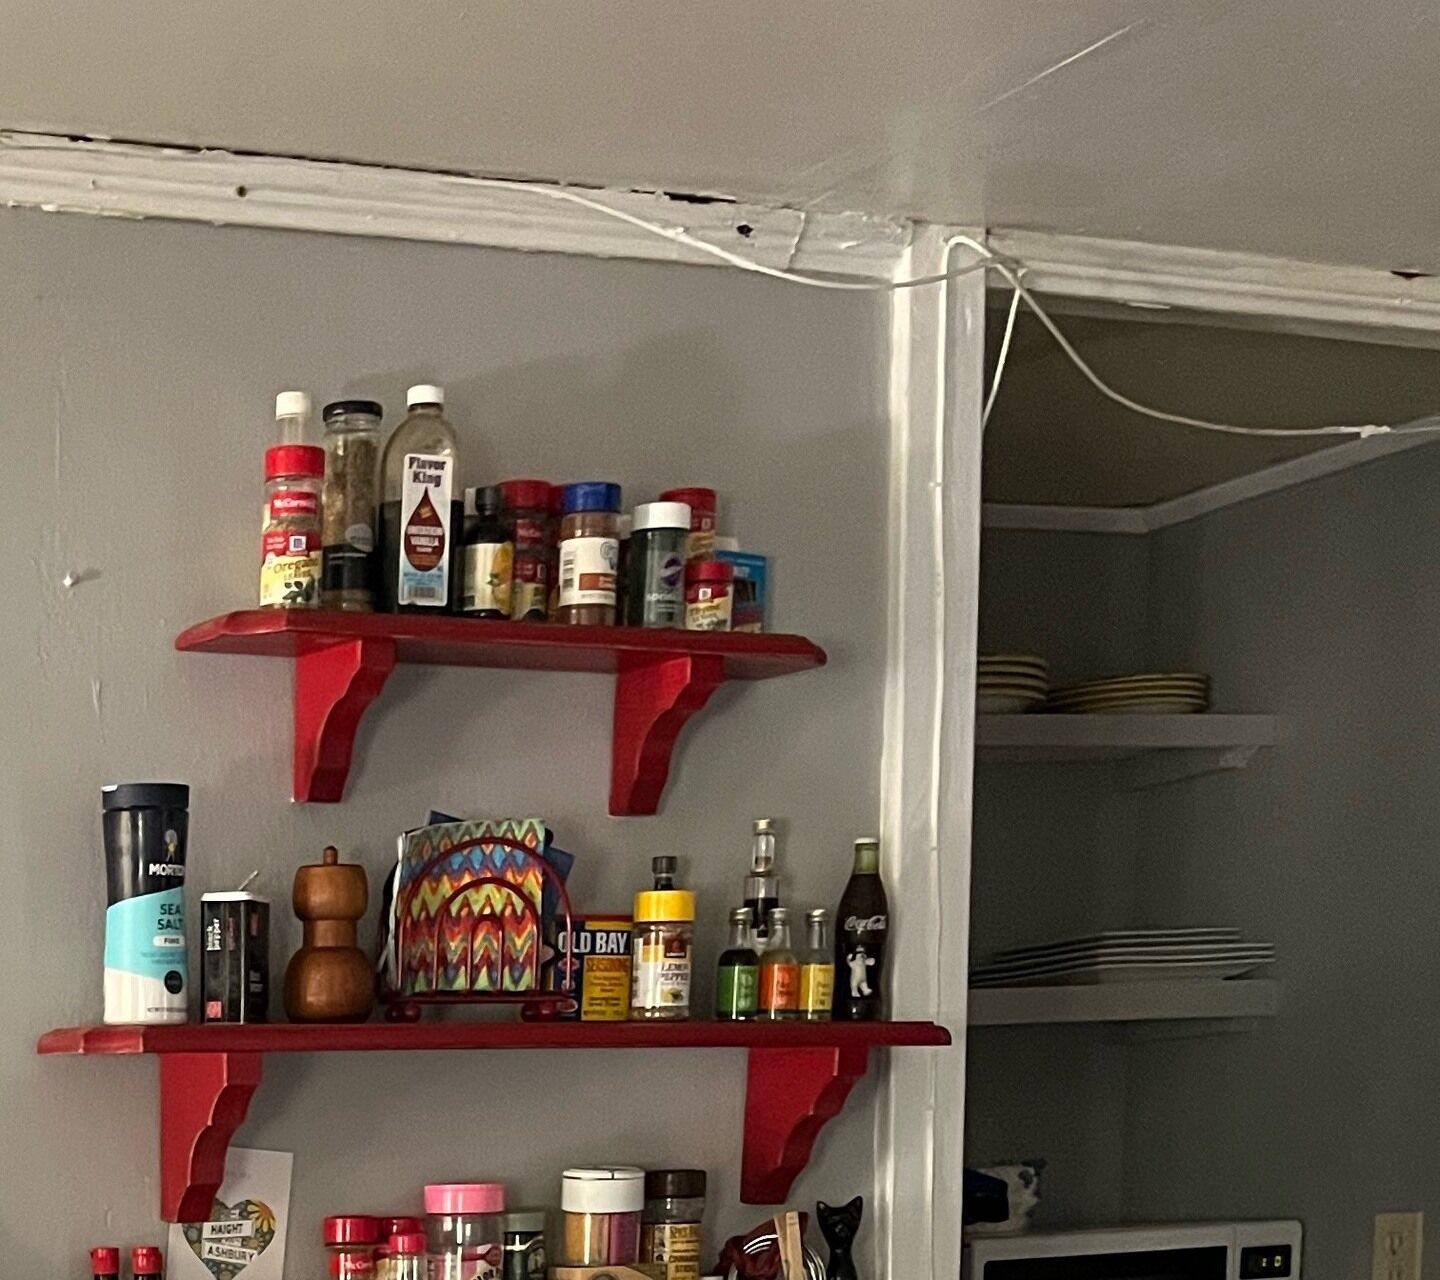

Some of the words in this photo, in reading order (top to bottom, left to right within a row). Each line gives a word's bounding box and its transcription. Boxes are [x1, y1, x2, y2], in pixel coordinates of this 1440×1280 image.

[408, 456, 447, 471] Flavor
[412, 471, 442, 488] King
[148, 863, 185, 877] MORTO
[160, 903, 182, 916] SEA
[157, 918, 184, 931] SALT
[558, 931, 592, 954] OLD
[595, 931, 628, 954] BAY
[210, 1223, 244, 1236] HAIGHT
[207, 1245, 256, 1263] ASHBURY
